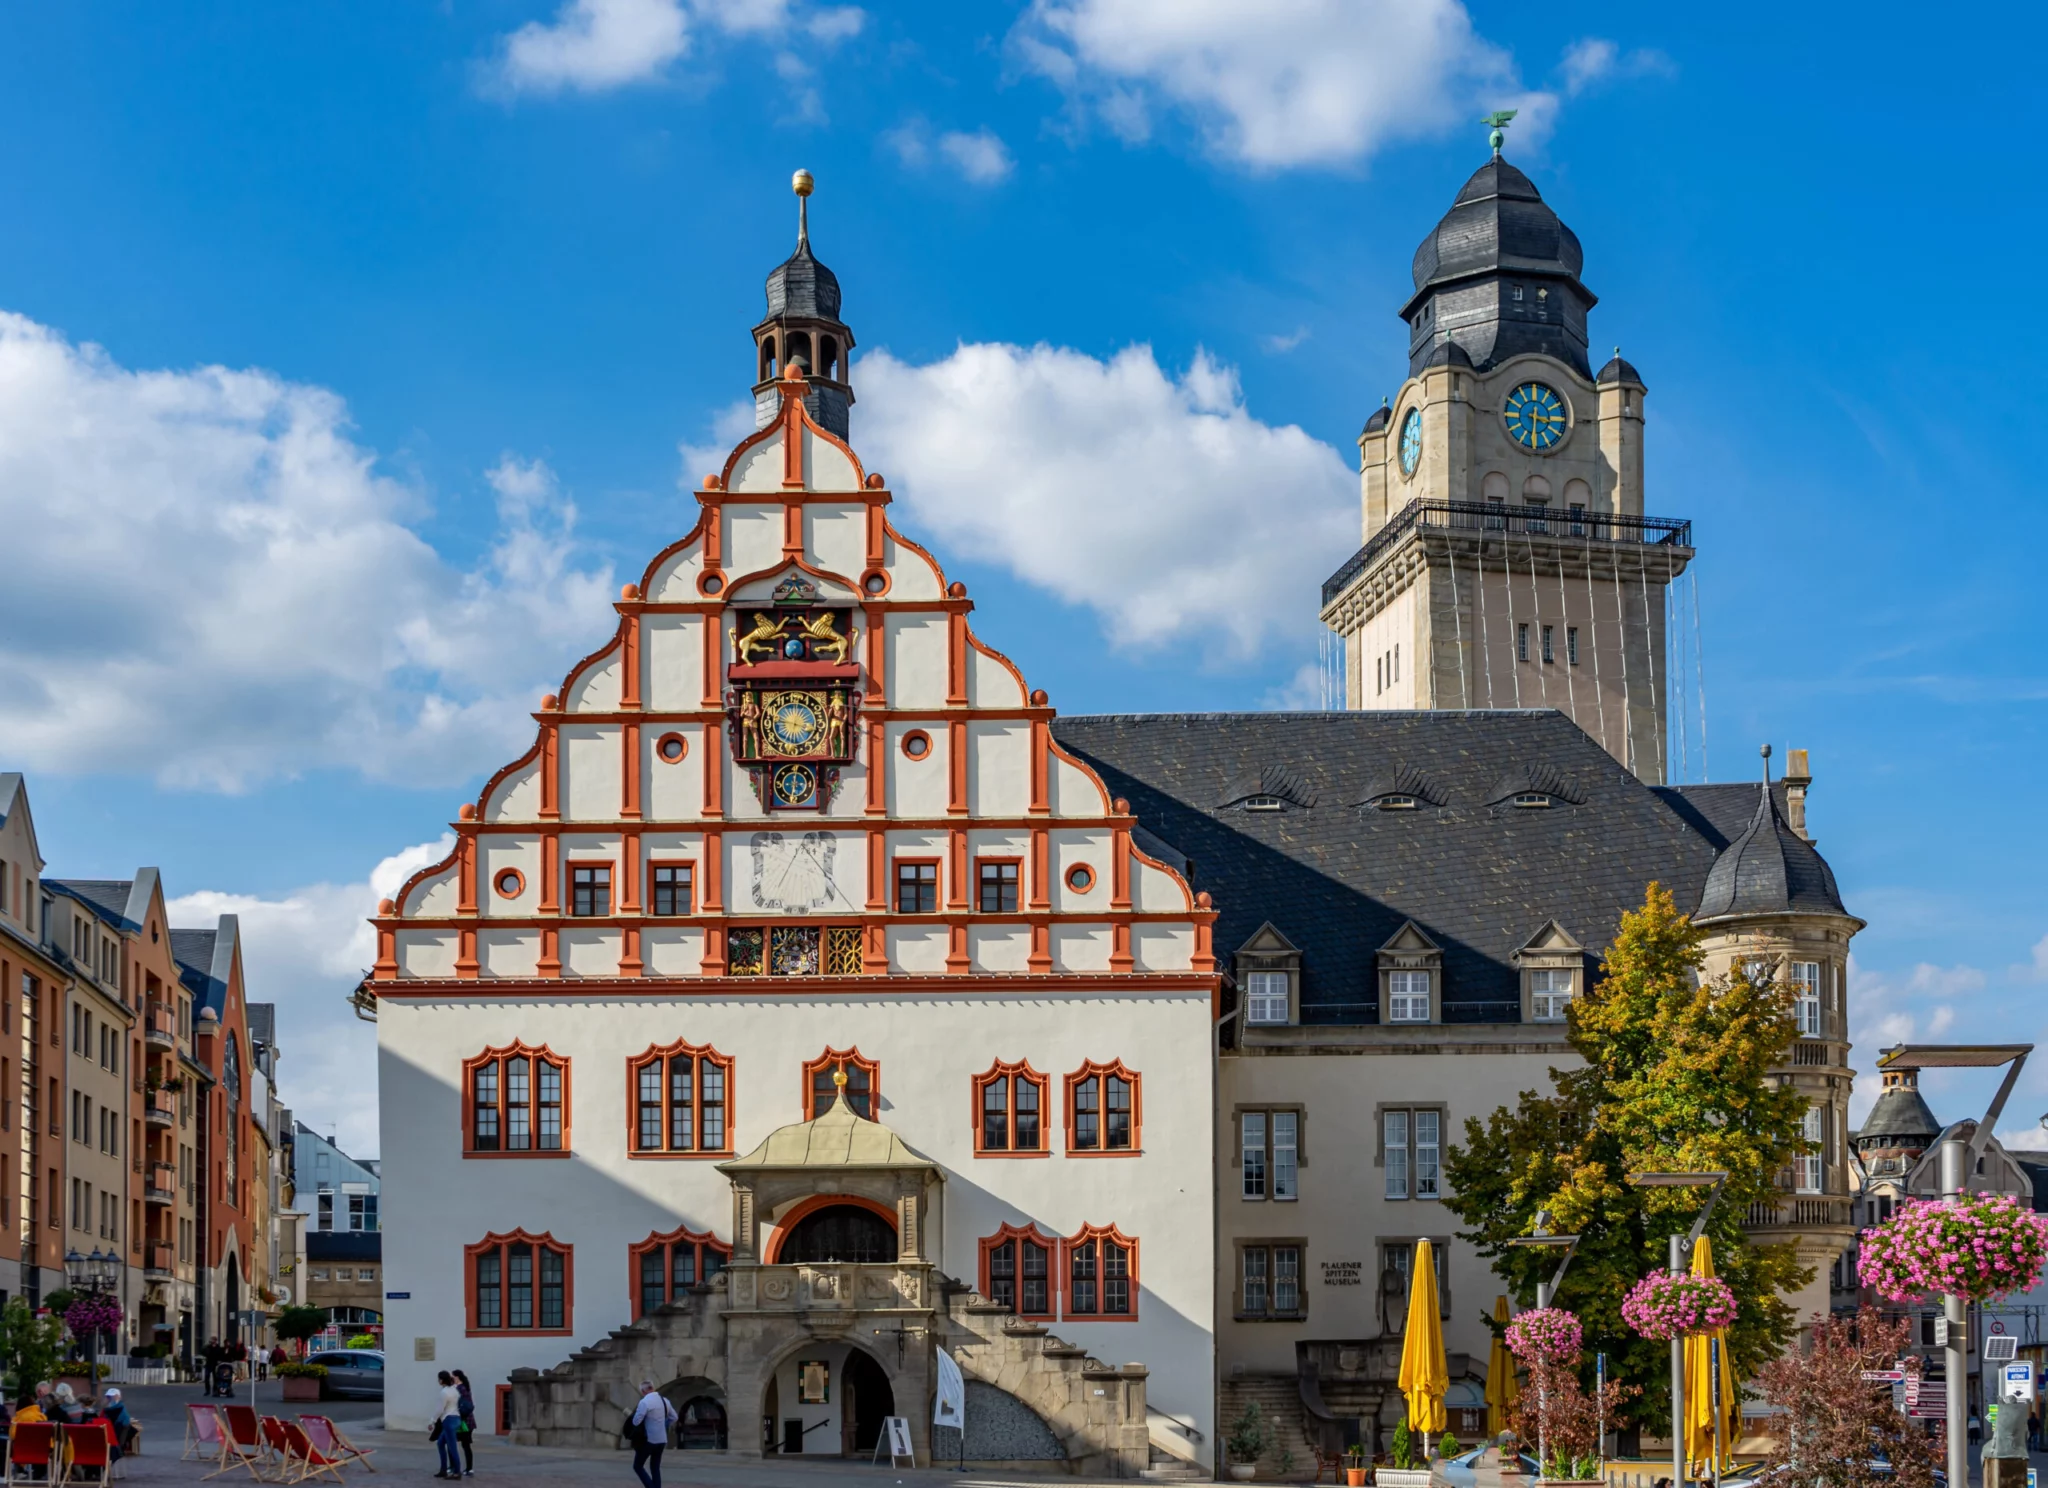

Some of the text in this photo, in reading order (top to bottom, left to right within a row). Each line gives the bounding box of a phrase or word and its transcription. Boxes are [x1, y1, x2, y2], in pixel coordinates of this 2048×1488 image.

[776, 695, 785, 706] 11
[804, 695, 809, 705] 1
[767, 705, 776, 716] 10
[814, 705, 822, 715] 2
[764, 719, 772, 729] 9
[817, 719, 826, 729] 3
[768, 732, 775, 743] 8
[804, 741, 813, 753] 5
[1321, 1261, 1362, 1269] PLAUENER
[1325, 1269, 1359, 1277] SPITZEN
[1324, 1278, 1361, 1286] MUSEUM
